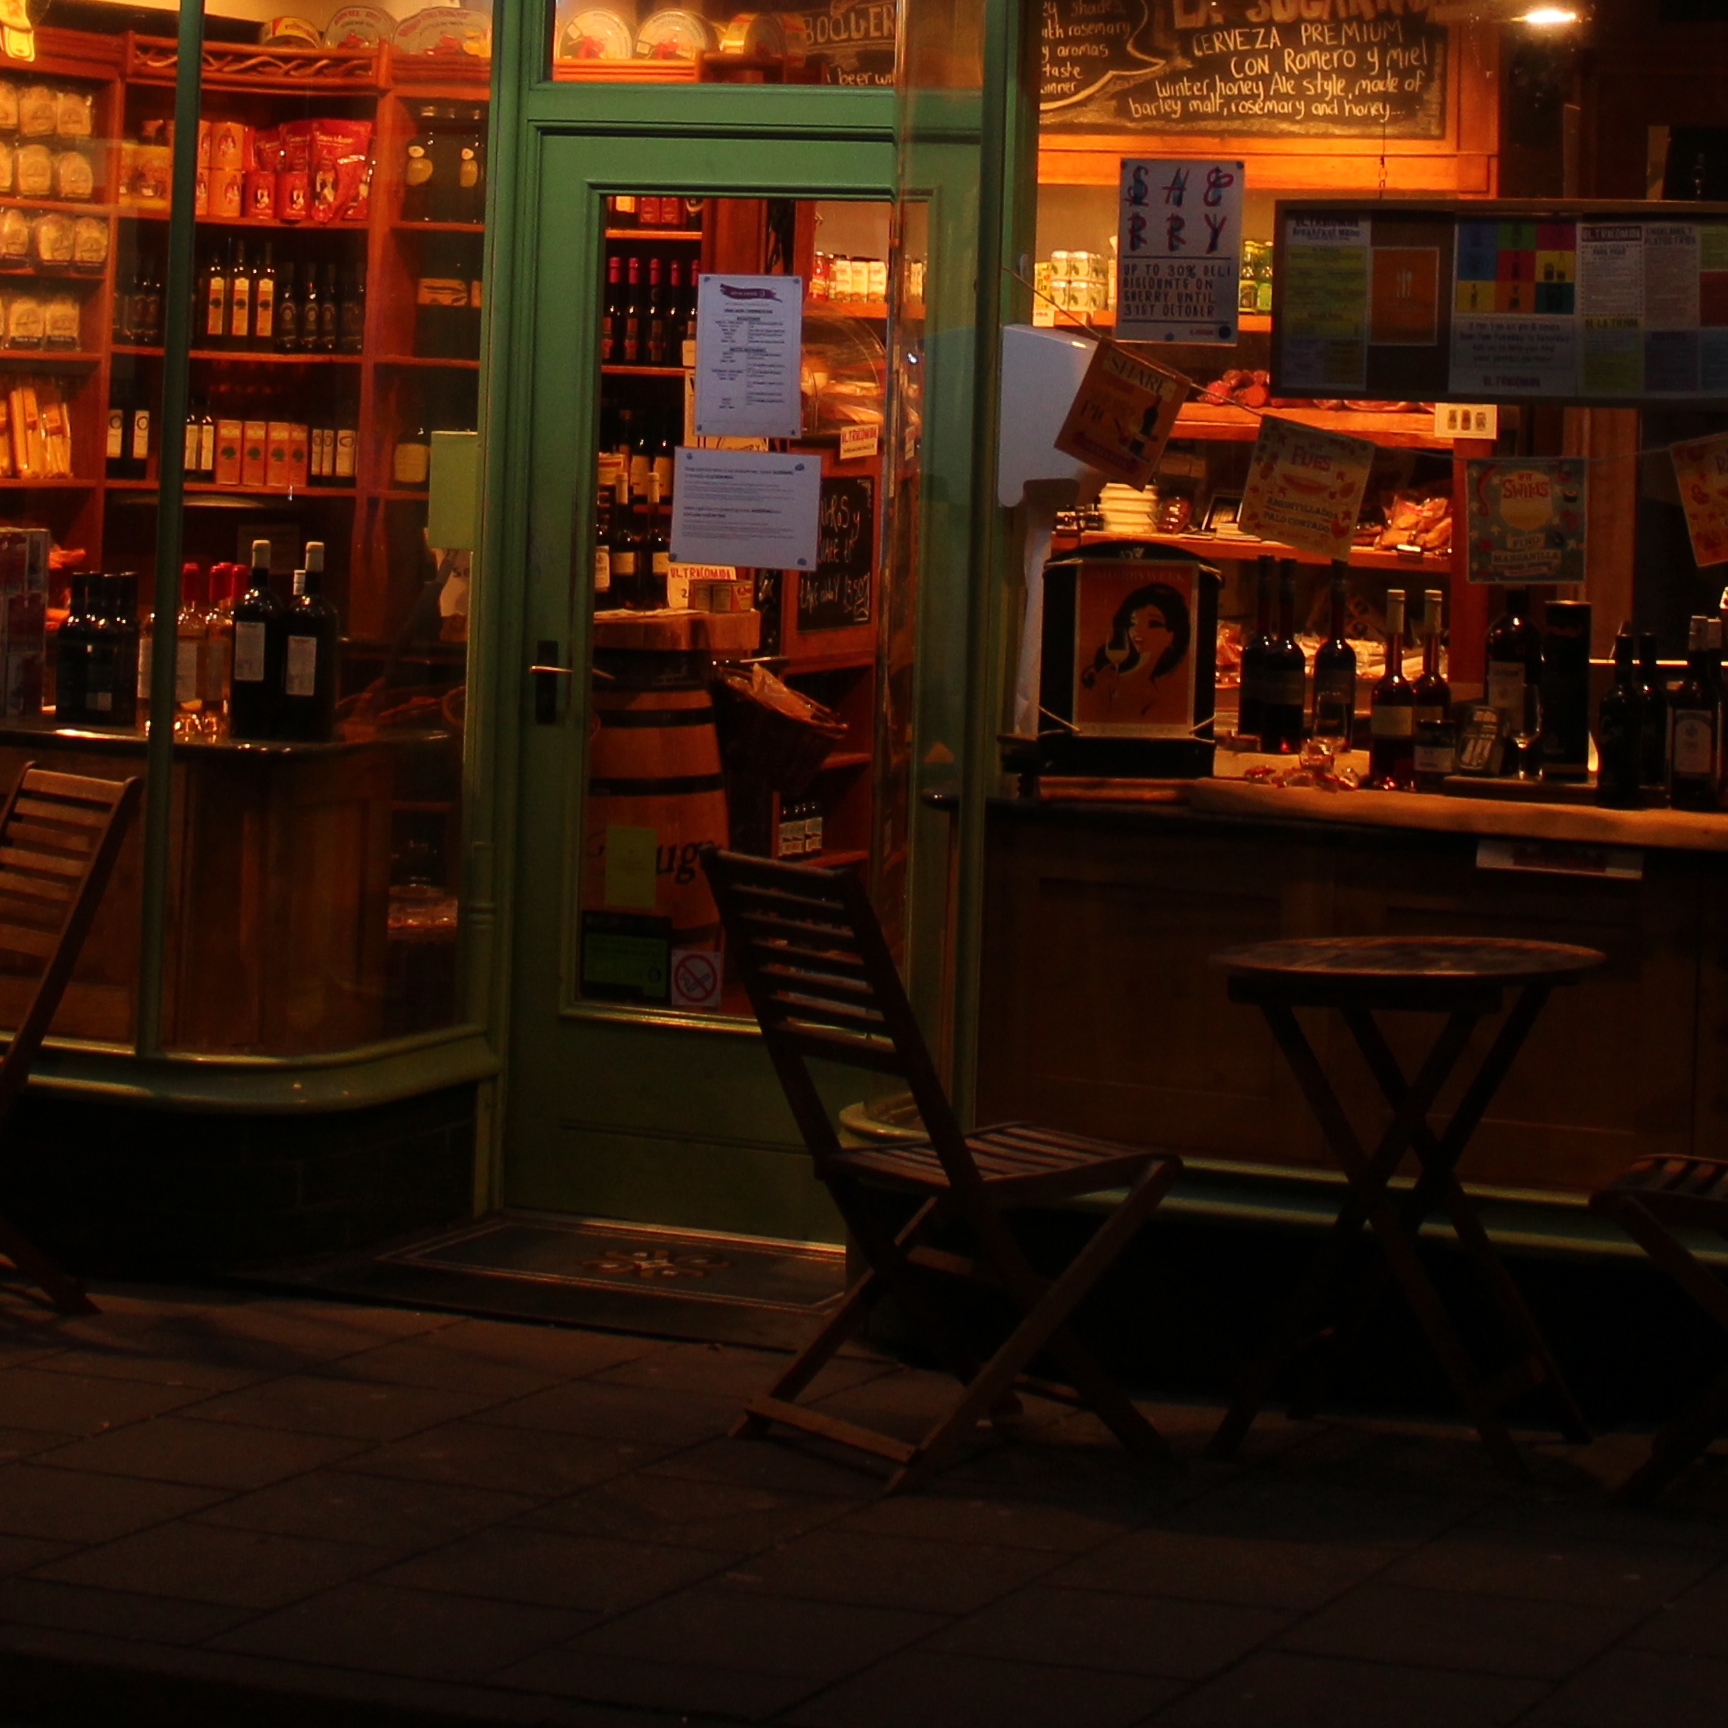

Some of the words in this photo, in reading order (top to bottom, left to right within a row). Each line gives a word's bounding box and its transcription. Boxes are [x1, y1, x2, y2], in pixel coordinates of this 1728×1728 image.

[1068, 20, 1132, 42] rosemary
[1192, 26, 1281, 57] CERVEZA
[1301, 18, 1404, 47] PREMIUM
[1056, 43, 1109, 59] aromas
[1042, 61, 1084, 80] taste
[1230, 55, 1270, 79] CON
[1284, 47, 1357, 74] Romero
[1367, 46, 1380, 76] y
[838, 68, 872, 86] beer
[1215, 74, 1265, 101] honey
[1269, 71, 1295, 95] Ale
[1355, 69, 1399, 96] made
[1403, 69, 1426, 93] of
[1128, 98, 1182, 119] barley
[1231, 99, 1305, 120] rosemary
[1311, 100, 1339, 116] and
[1123, 263, 1138, 277] UP
[1145, 263, 1161, 277] TO
[1167, 264, 1197, 279] 30%
[1202, 265, 1233, 278] DELI
[1123, 277, 1190, 291] DISCOUNTS
[1195, 279, 1214, 291] ON
[1123, 291, 1170, 304] SHERRY
[1176, 292, 1216, 305] UNTIL
[1124, 304, 1156, 316] 31ST
[1162, 304, 1215, 318] OCTOBER
